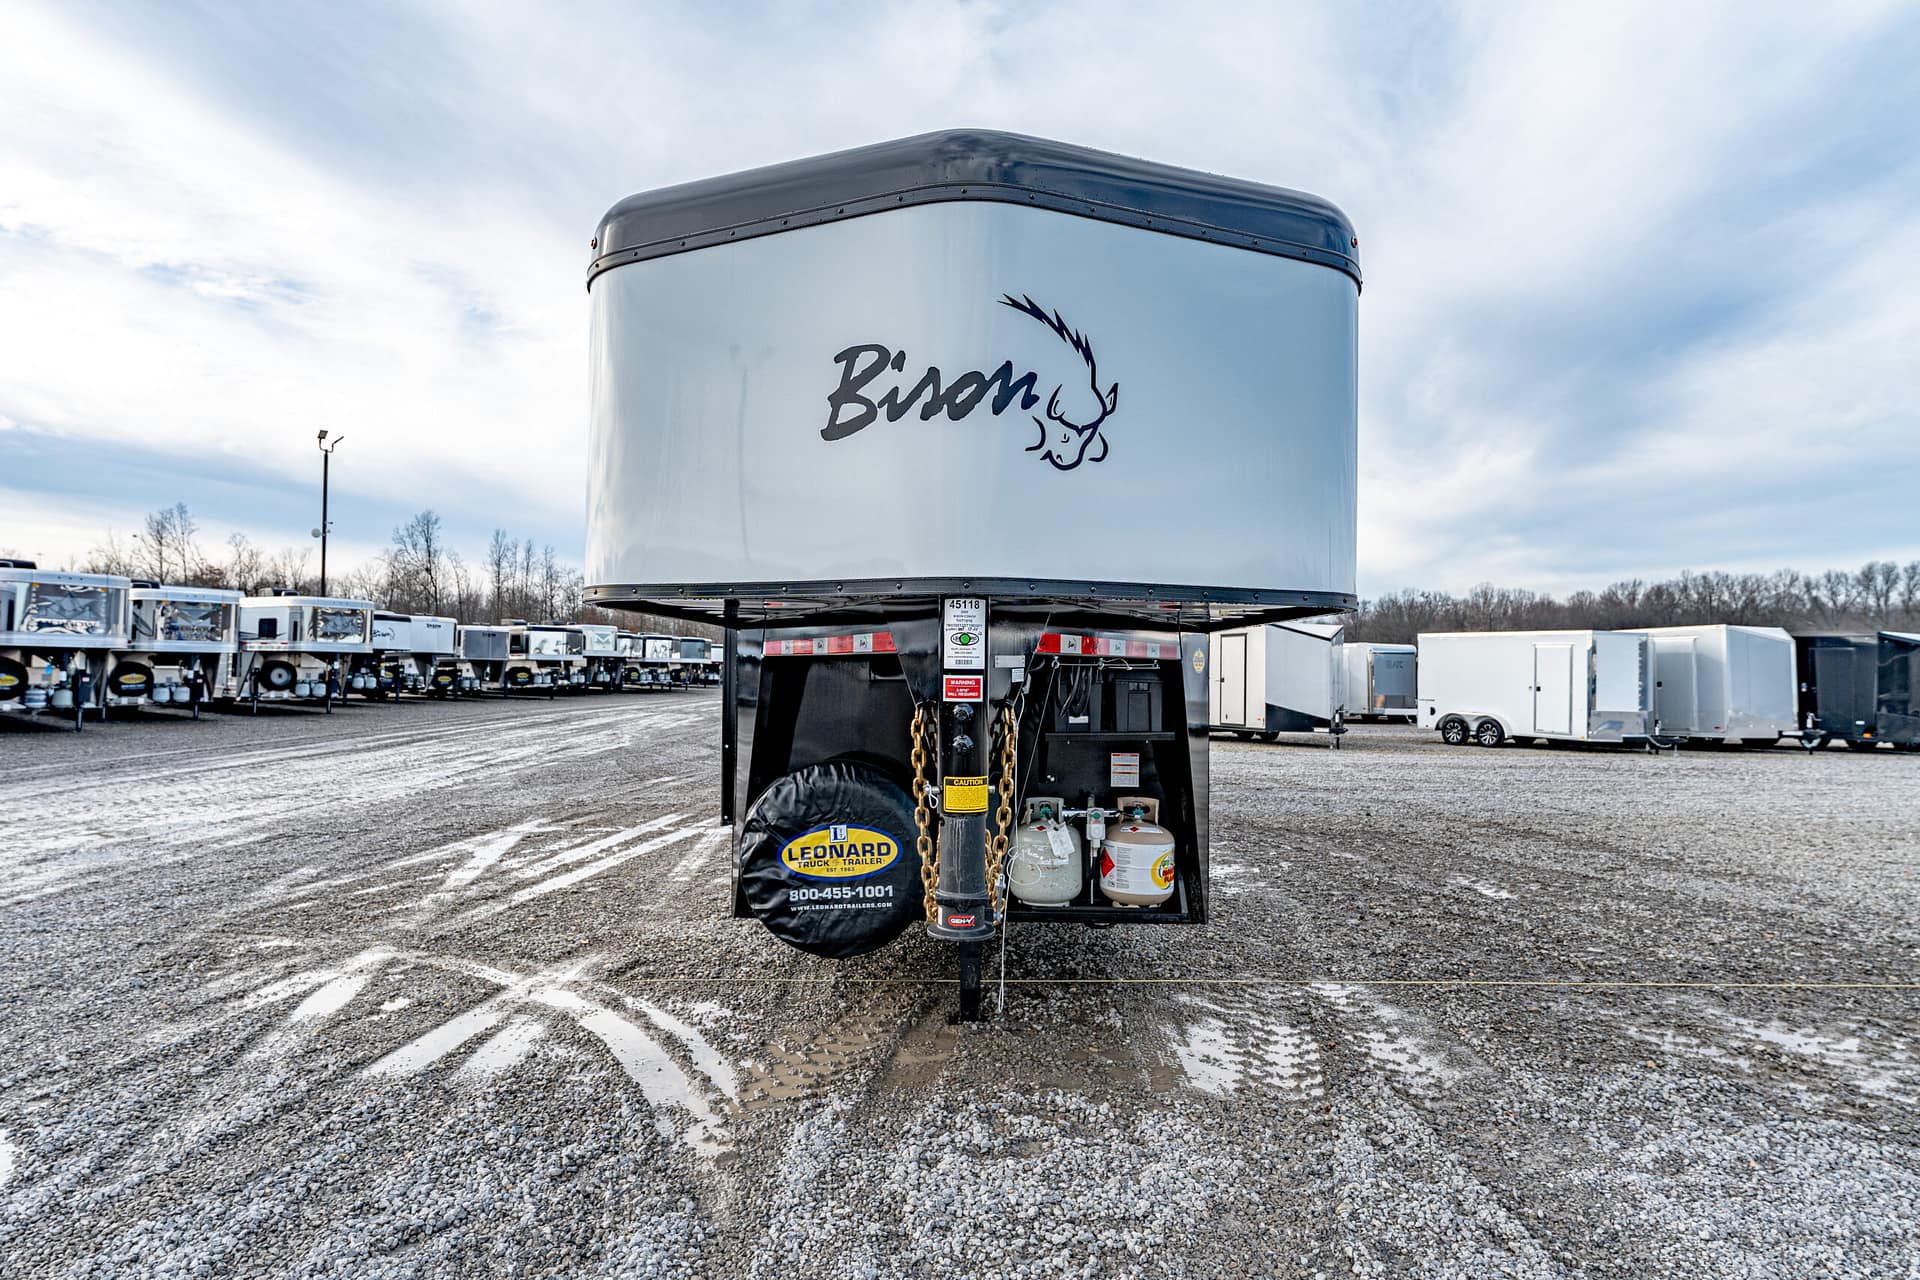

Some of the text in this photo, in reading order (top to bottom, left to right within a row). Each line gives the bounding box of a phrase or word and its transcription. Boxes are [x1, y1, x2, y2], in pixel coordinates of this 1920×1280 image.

[820, 343, 1040, 441] Bison
[949, 600, 980, 610] 45118
[788, 842, 891, 862] LEONARD
[797, 859, 830, 869] TRUCK
[842, 857, 882, 866] TRAILER
[789, 885, 894, 902] 800-455-1001
[790, 902, 893, 912] WWW.LEONARDTRAILERS.COM
